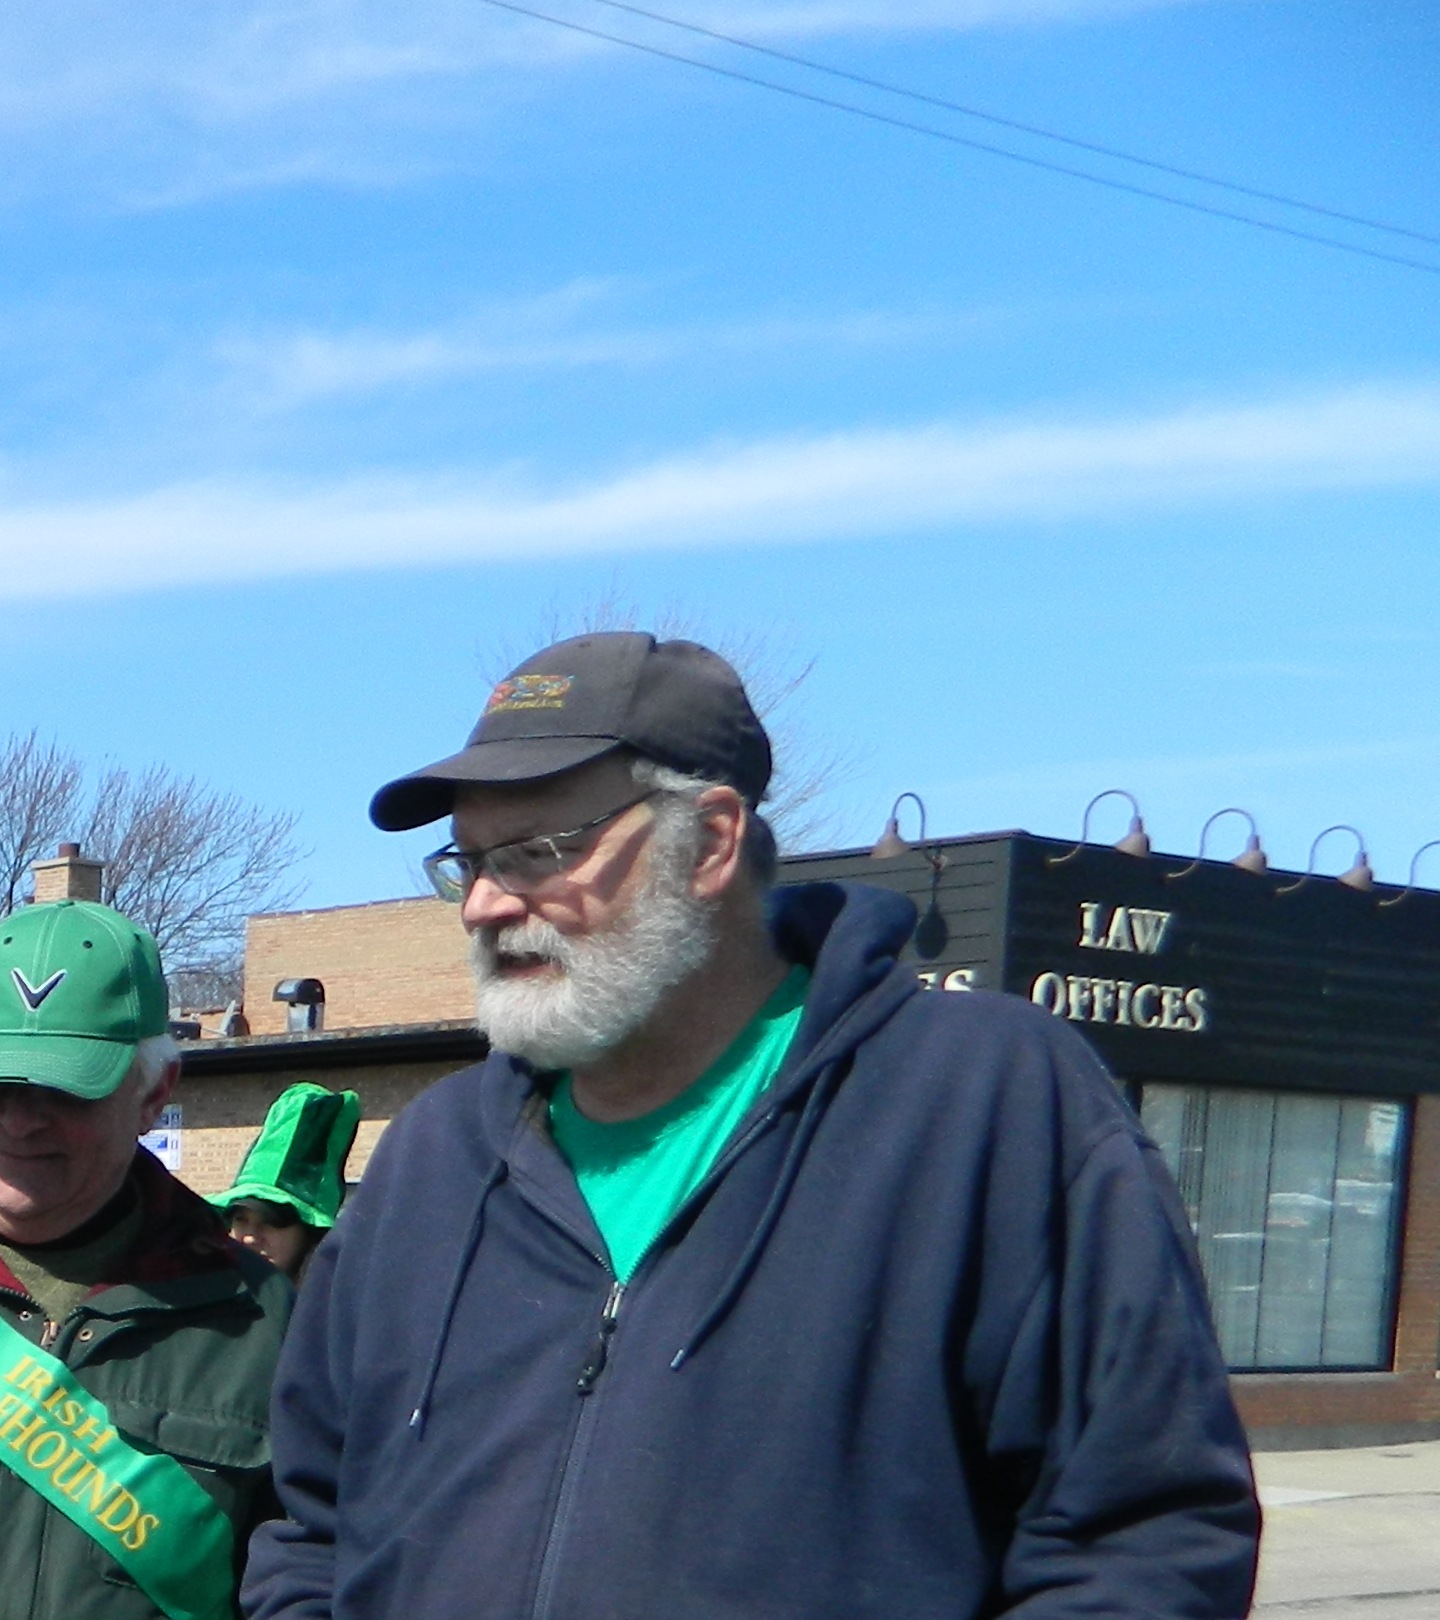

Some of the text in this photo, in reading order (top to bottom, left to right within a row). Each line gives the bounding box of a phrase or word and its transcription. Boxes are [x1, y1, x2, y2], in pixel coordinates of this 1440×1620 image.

[1079, 902, 1171, 954] LAW
[1031, 972, 1208, 1032] OFFICES
[4, 1355, 119, 1454] IRISH
